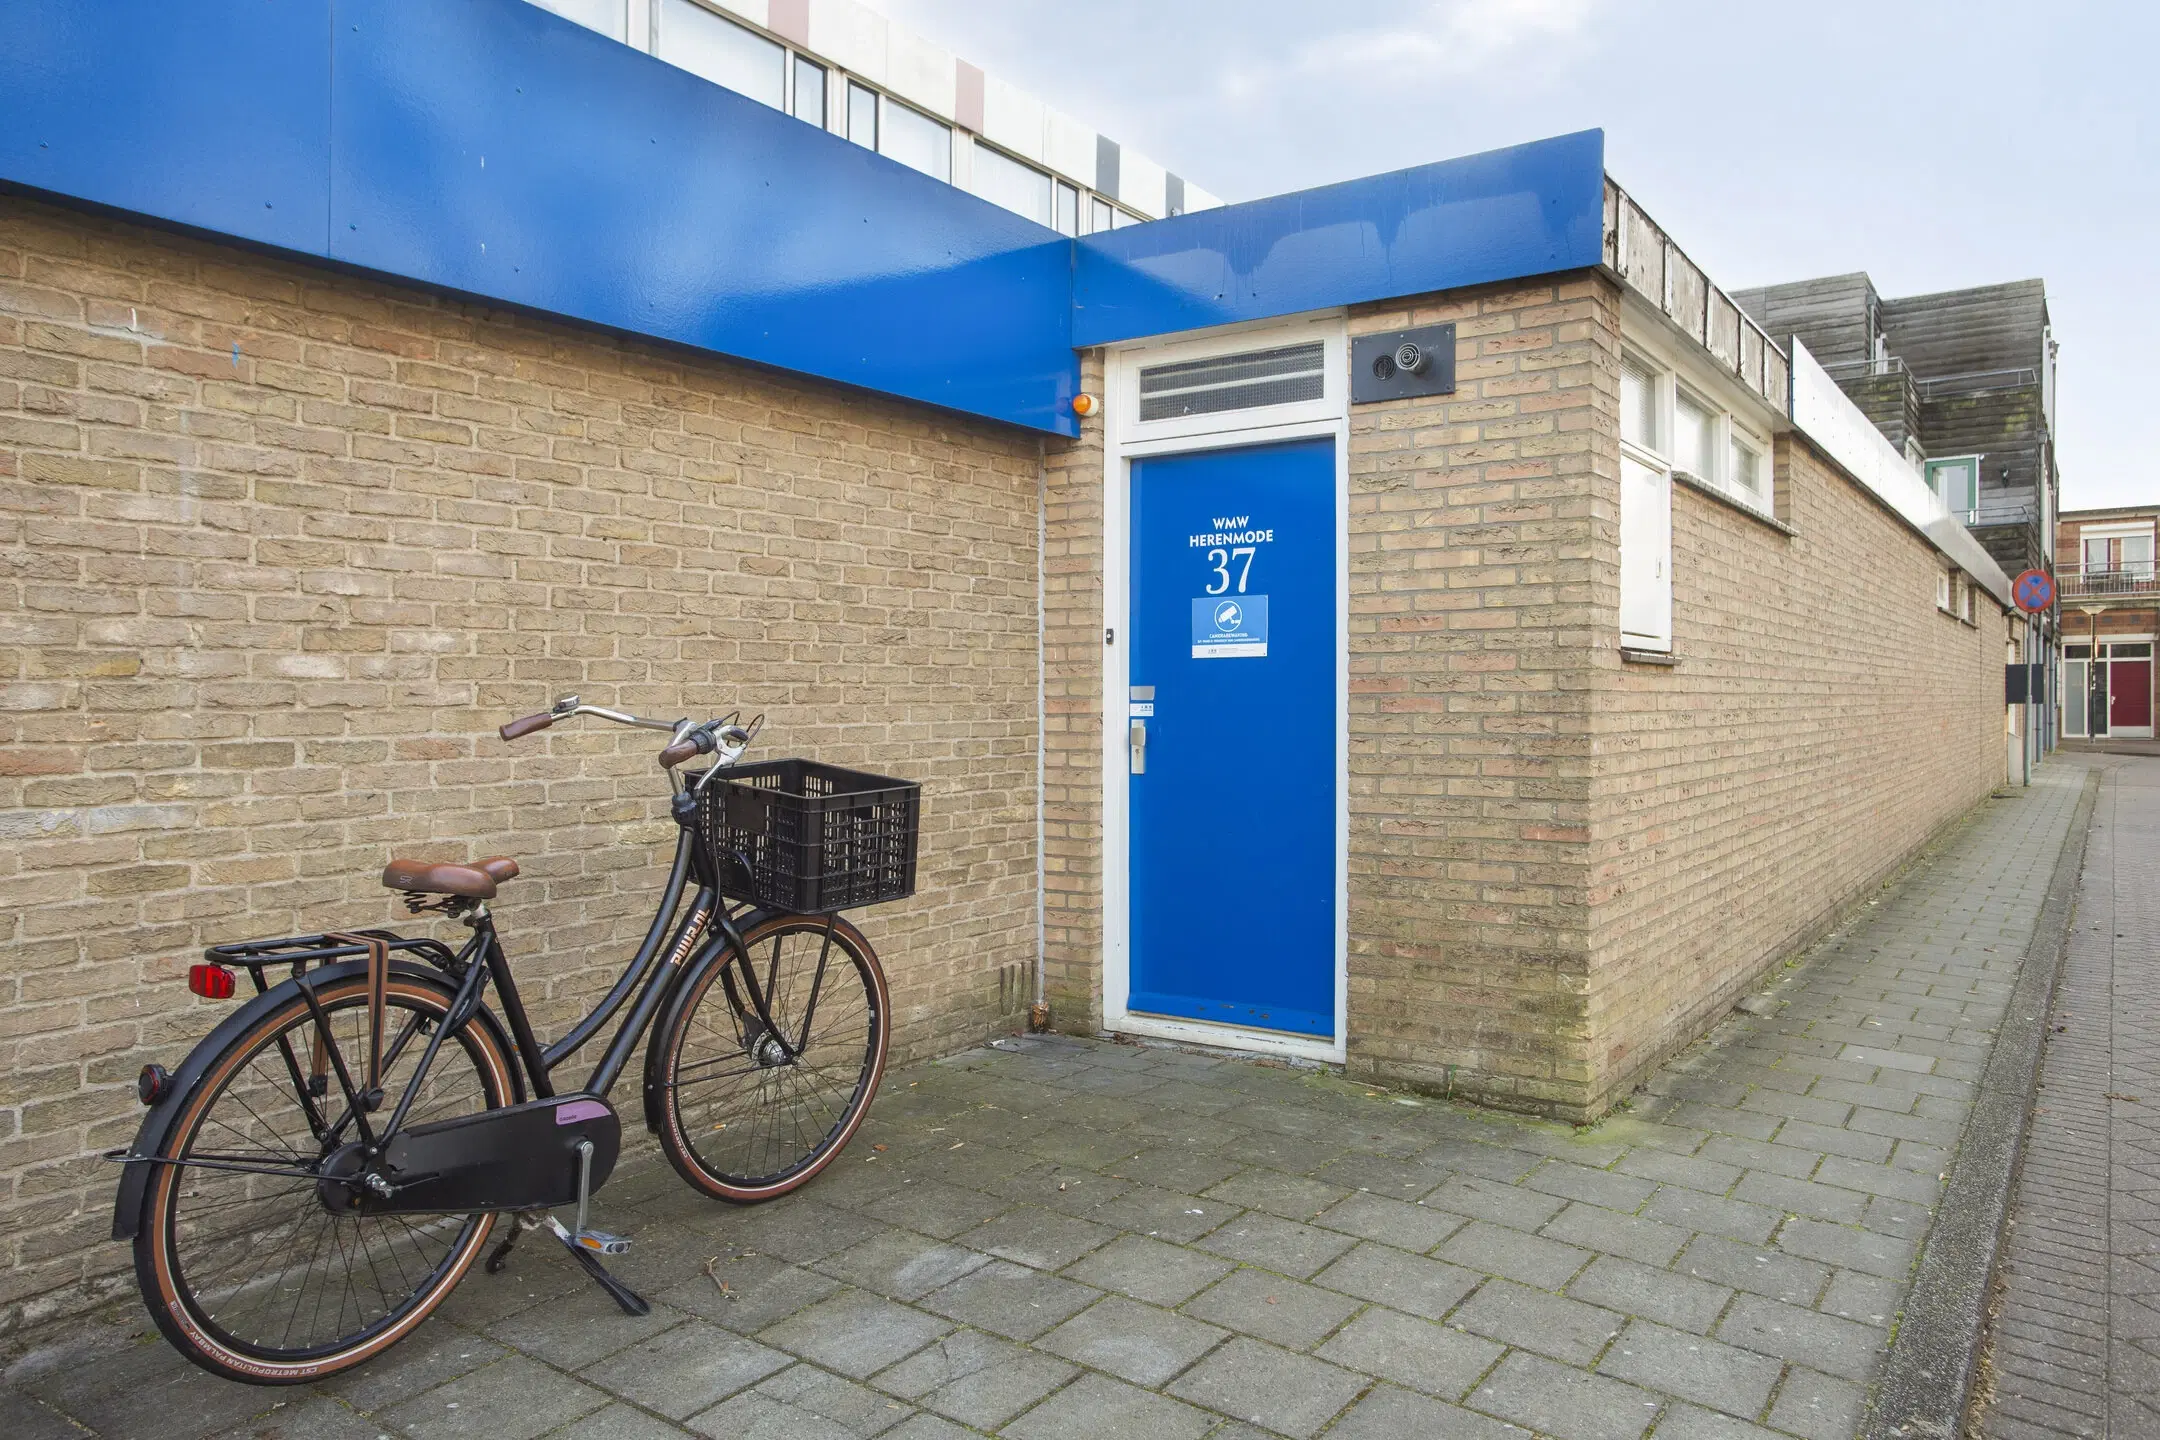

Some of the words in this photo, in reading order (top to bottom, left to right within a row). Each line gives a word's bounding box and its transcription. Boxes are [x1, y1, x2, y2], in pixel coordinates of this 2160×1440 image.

[1212, 515, 1249, 530] WMW
[1189, 529, 1274, 548] HERENMODE
[1205, 546, 1256, 595] 37
[189, 1330, 227, 1361] PALMBAY
[225, 1358, 299, 1376] METROPOLITAN
[299, 1366, 318, 1375] CST
